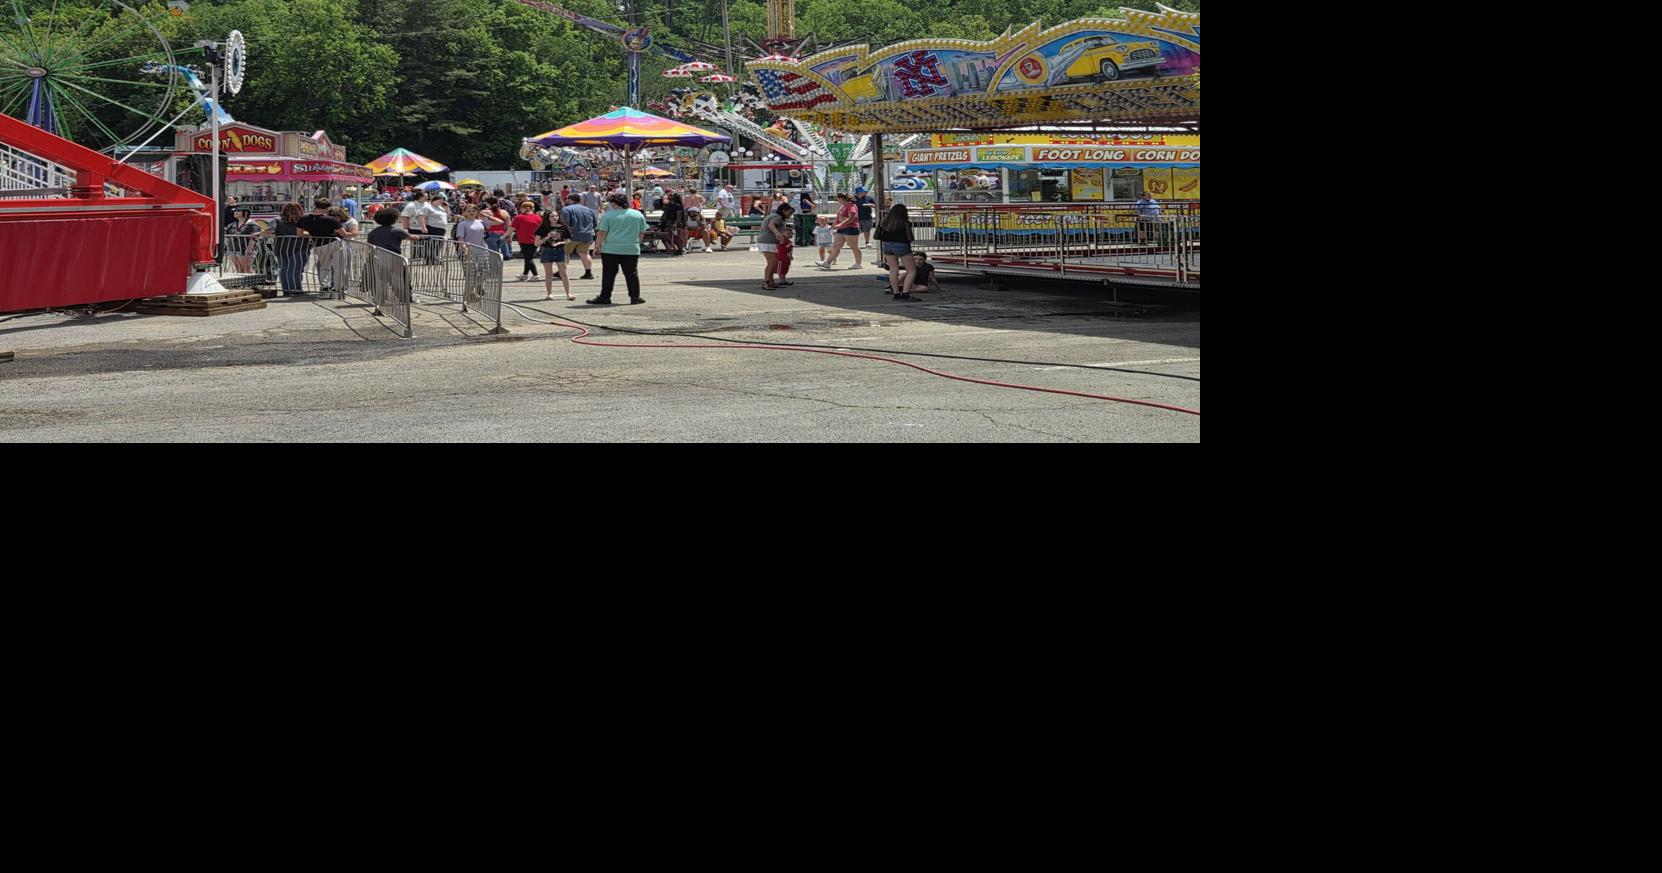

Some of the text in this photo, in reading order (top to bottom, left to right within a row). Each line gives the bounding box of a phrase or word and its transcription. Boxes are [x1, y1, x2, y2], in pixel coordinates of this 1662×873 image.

[198, 134, 272, 150] CON DOGS
[912, 150, 968, 162] GIANT PRETZELS
[1038, 150, 1125, 160] FOOT LONG
[1136, 150, 1175, 160] CORN
